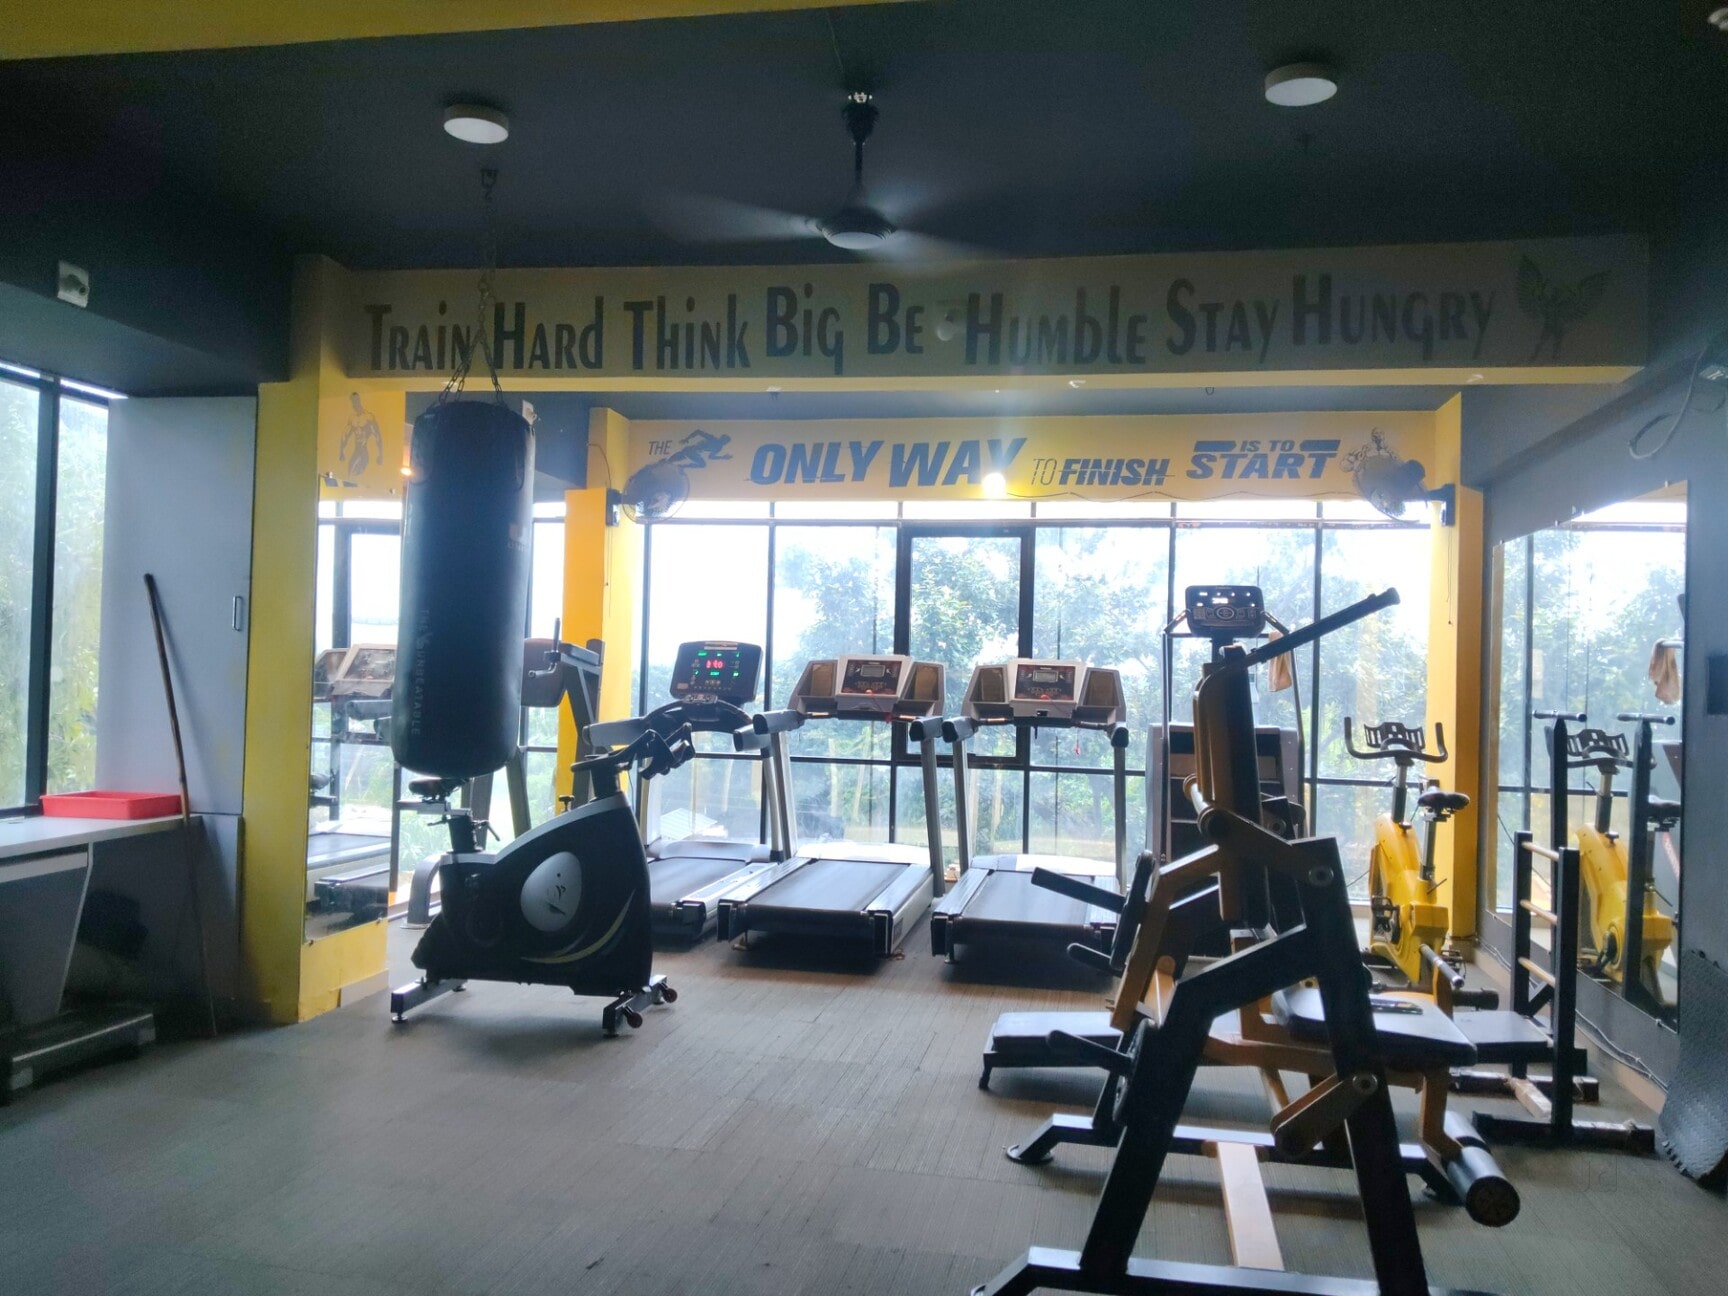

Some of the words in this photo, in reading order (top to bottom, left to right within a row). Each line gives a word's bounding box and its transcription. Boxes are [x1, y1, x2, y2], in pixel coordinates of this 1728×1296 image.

[1239, 439, 1262, 453] IS
[1268, 439, 1297, 453] TO
[648, 440, 673, 456] THE
[748, 439, 885, 486] ONLY
[887, 437, 1028, 488] WAY
[1031, 458, 1058, 486] TO
[1058, 458, 1171, 486] FINISH
[1186, 452, 1338, 480] START
